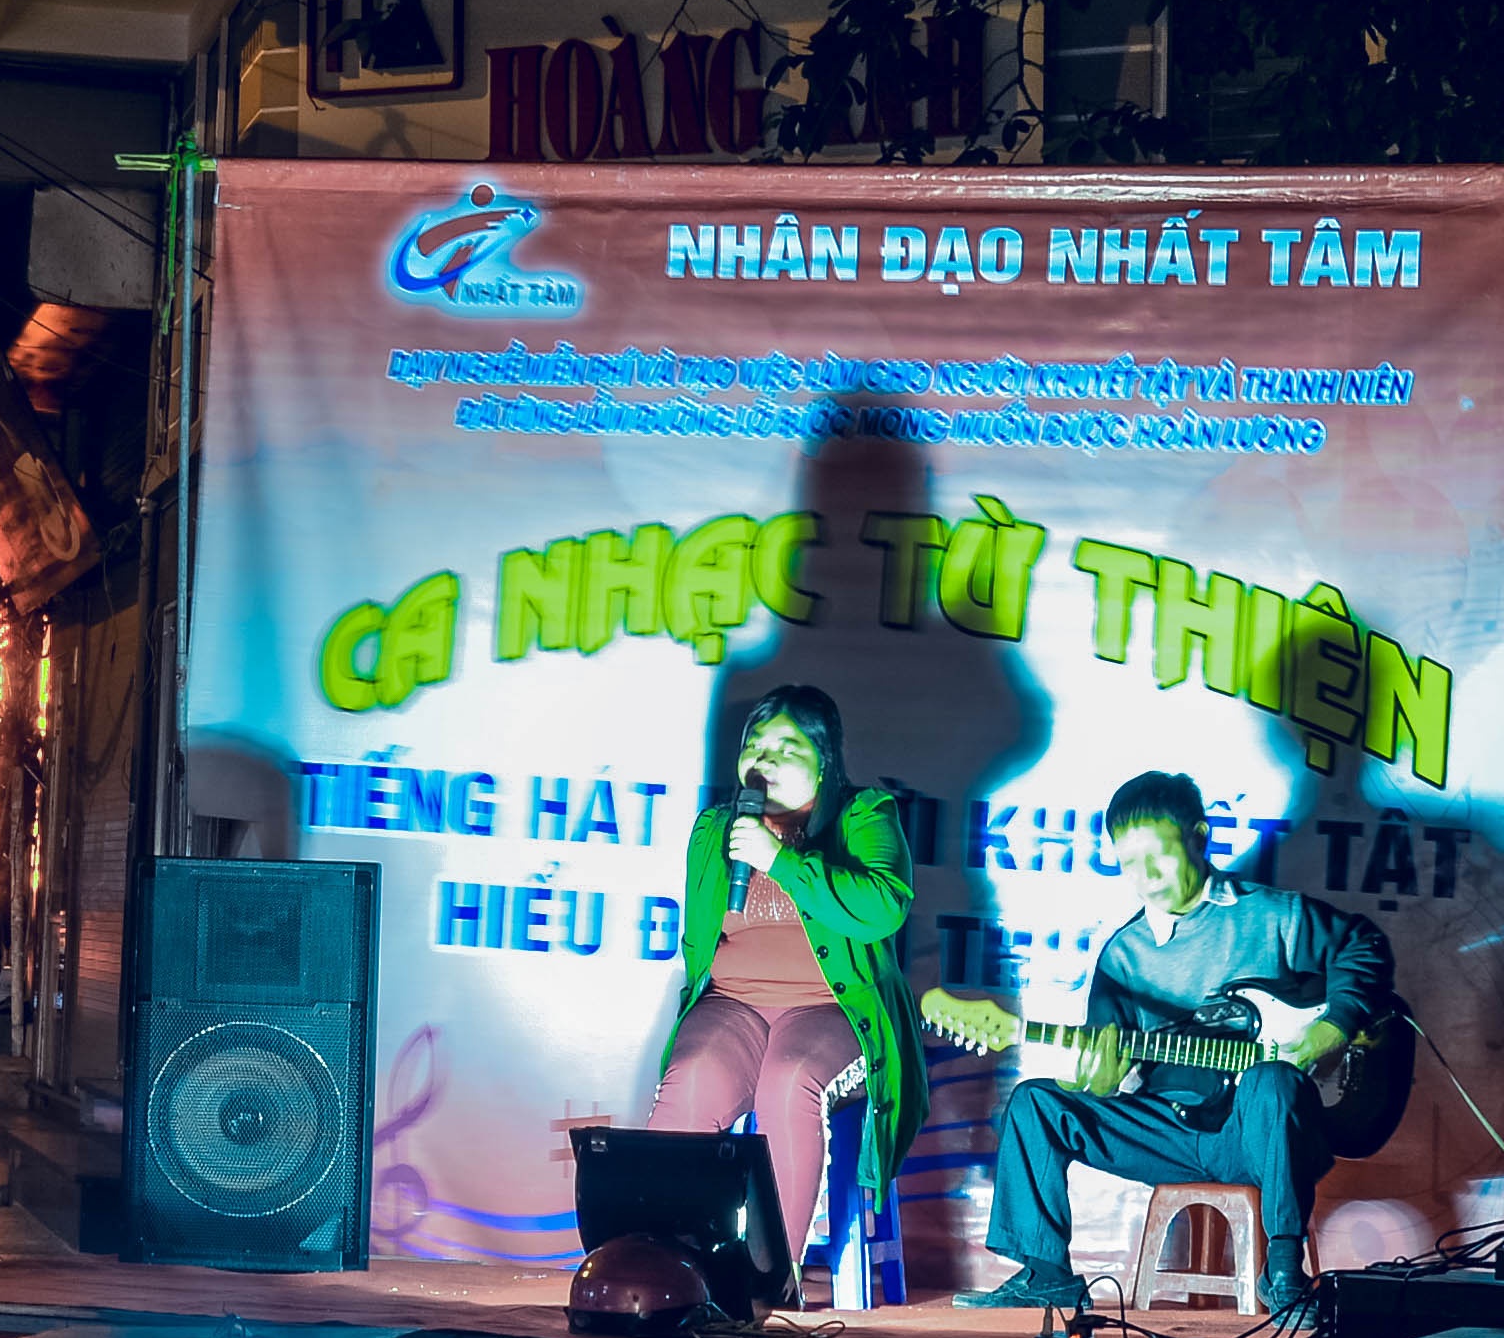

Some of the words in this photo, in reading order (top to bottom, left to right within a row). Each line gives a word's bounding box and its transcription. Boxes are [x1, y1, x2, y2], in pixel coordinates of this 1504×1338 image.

[486, 15, 765, 162] HOÀNG
[665, 213, 860, 282] NHÂN
[880, 225, 1023, 296] ĐẠO
[1047, 209, 1240, 287] NHẤT
[1261, 217, 1422, 289] TÂM
[1240, 366, 1341, 406] THANH
[1341, 361, 1414, 407] NIÊN
[317, 569, 461, 713] CA
[493, 510, 824, 666] NHẠC
[860, 493, 1045, 642] TỪ
[1073, 536, 1453, 791] THIỆN
[300, 743, 496, 838] TIẾNG
[529, 764, 667, 847] HÁT
[1316, 806, 1473, 913] TẬT
